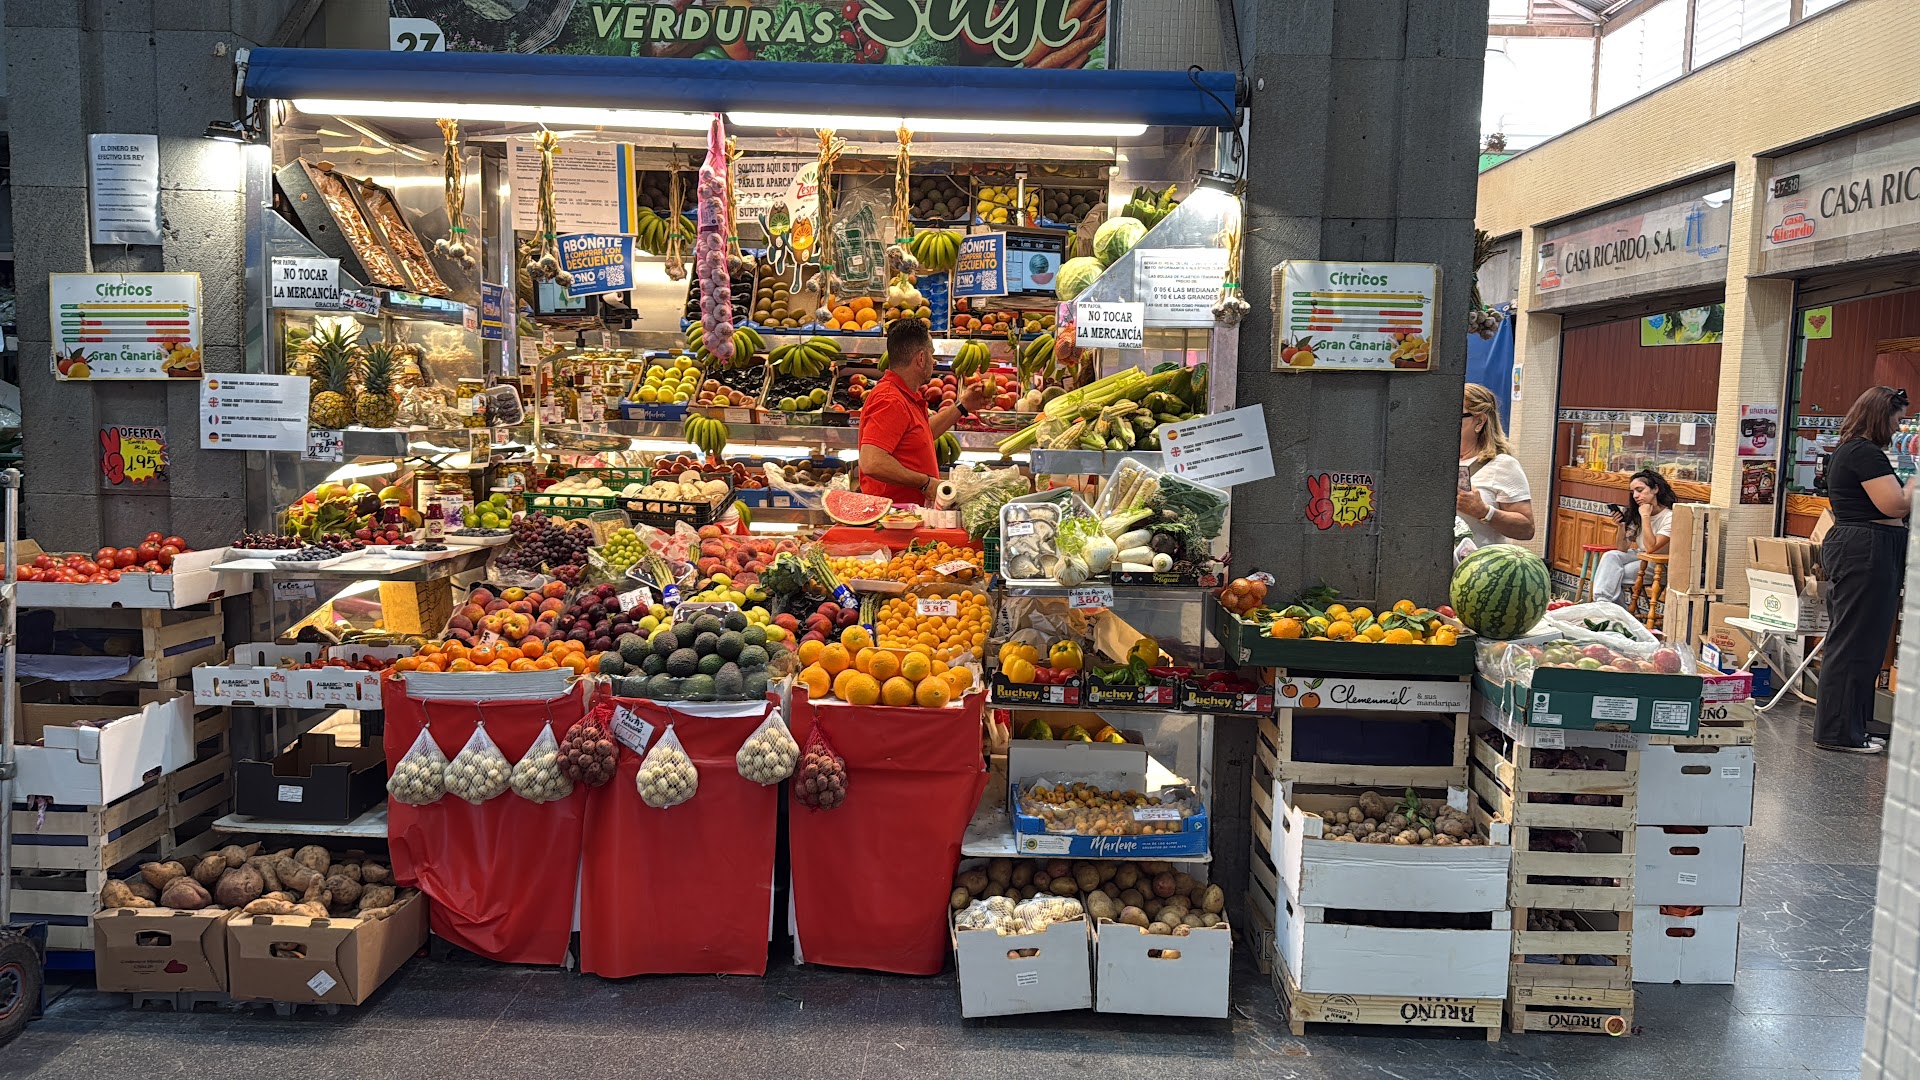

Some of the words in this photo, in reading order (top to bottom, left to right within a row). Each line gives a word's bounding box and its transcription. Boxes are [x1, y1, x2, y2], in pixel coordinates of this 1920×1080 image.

[592, 4, 837, 46] VERDURAS
[396, 32, 440, 51] 27
[737, 162, 765, 173] SOLICITE
[766, 163, 781, 174] AQUI
[782, 163, 791, 172] SU
[738, 178, 755, 187] PARA
[756, 178, 764, 187] EL
[1775, 178, 1799, 196] 37-38
[1820, 178, 1873, 219] CASA
[1880, 166, 1920, 207] RIC
[1784, 214, 1803, 226] casa
[1773, 223, 1813, 242] Ricardo
[563, 236, 623, 253] ABÓNATE
[1565, 249, 1591, 274] CASA
[1593, 234, 1650, 268] RICARDO,
[1654, 227, 1676, 255] S.A.
[570, 248, 603, 259] COMPRAR
[604, 247, 621, 255] CON
[983, 251, 996, 259] CON
[566, 253, 624, 270] DESCUENTO
[283, 268, 296, 280] NO
[298, 268, 328, 281] TOCAR
[1329, 271, 1388, 286] Cítricos
[96, 283, 153, 297] Cítricos
[274, 286, 285, 298] LA
[286, 284, 339, 300] MERCANCÍA
[1088, 311, 1101, 321] NO
[1103, 311, 1133, 323] TOCAR
[1077, 326, 1089, 338] LA
[1090, 326, 1142, 340] MERCANCÍA
[1318, 339, 1346, 351] Gran
[1348, 340, 1392, 352] Canaria
[92, 350, 118, 361] Gran
[120, 350, 163, 361] Canaria
[121, 427, 162, 438] OFERTA
[126, 454, 156, 471] 1.95
[1332, 473, 1373, 485] OFERTA
[1336, 506, 1369, 522] 1.50
[1766, 599, 1779, 610] HSB
[996, 684, 1040, 701] Ruchey
[1330, 684, 1412, 705] Clemenmiel
[1416, 699, 1461, 707] mandarinas
[1090, 836, 1138, 856] Marlene
[1400, 1002, 1476, 1024] BRUÑÓ
[1548, 1014, 1602, 1031] BRUÑÓ
